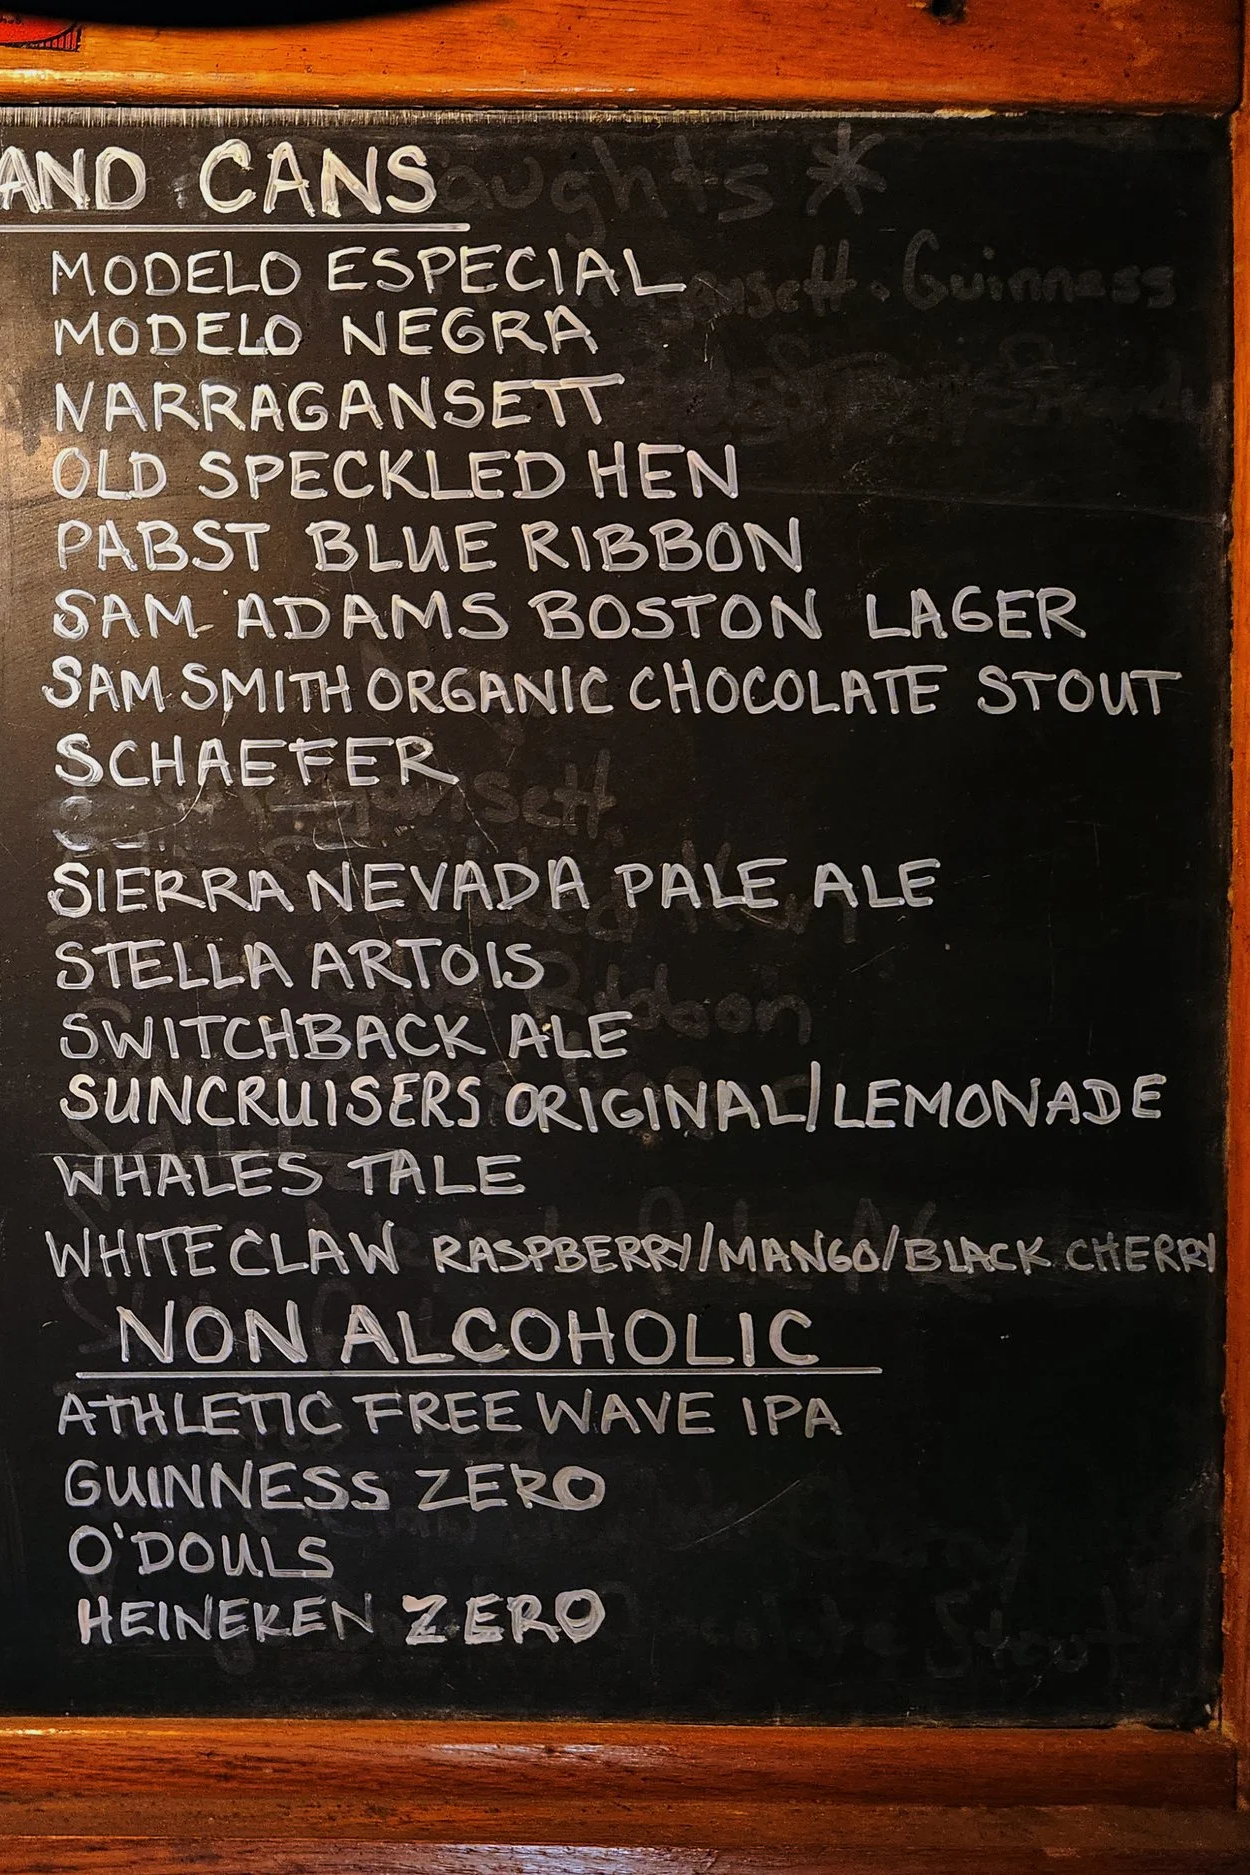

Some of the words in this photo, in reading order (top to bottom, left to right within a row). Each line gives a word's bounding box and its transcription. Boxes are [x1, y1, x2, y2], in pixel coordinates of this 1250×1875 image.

[200, 139, 436, 217] CANS
[52, 250, 301, 296] MODELO
[328, 245, 686, 296] ESPECIAL
[54, 312, 302, 355] MODELO
[343, 305, 598, 355] NEGRA
[55, 373, 625, 433] NARRAGANSETT
[51, 447, 166, 500] OLD
[199, 450, 565, 500] SPECKLED
[588, 441, 738, 499] HEN
[58, 520, 270, 571] PABST
[305, 520, 497, 572] BLUE
[522, 517, 802, 573] RIBBON
[53, 589, 195, 640] SAM
[238, 591, 508, 639] ADAMS
[528, 588, 822, 639] BOSTON
[867, 586, 1086, 639] LAGER
[42, 656, 165, 712] SAM
[181, 663, 352, 714] SMITH
[367, 666, 613, 714] ORGANIC
[630, 659, 947, 714] CHOCOLATE
[978, 666, 1182, 715] STOUT
[55, 733, 460, 788] SCHAEFER
[48, 862, 294, 918] SIERRA
[307, 856, 590, 912] NEVADA
[614, 859, 787, 909] PALE
[814, 859, 940, 907] ALE
[55, 939, 293, 990] STELLA
[312, 938, 544, 989] ARTOIS
[60, 1008, 486, 1059] SWITCHBACK
[509, 1011, 632, 1059] ALE
[60, 1071, 480, 1127] SUNCRUISERS
[53, 1150, 323, 1197] WHALES
[347, 1149, 525, 1195] TALE
[45, 1224, 222, 1277] WHITE
[230, 1220, 399, 1275] CLAW
[1065, 1232, 1216, 1274] CHERRY
[116, 1300, 308, 1363] NON
[341, 1305, 819, 1367] ALCOHOLIC
[59, 1391, 342, 1435] ATHLETIC
[352, 1390, 522, 1434] FREE
[536, 1389, 715, 1434] WAVE
[743, 1395, 839, 1435] IPA
[65, 1460, 389, 1510] GUINNESS
[415, 1464, 605, 1511] ZERO
[69, 1522, 334, 1578] O'DOULS
[78, 1594, 373, 1644] HEINEKEN
[403, 1589, 605, 1645] ZERO
